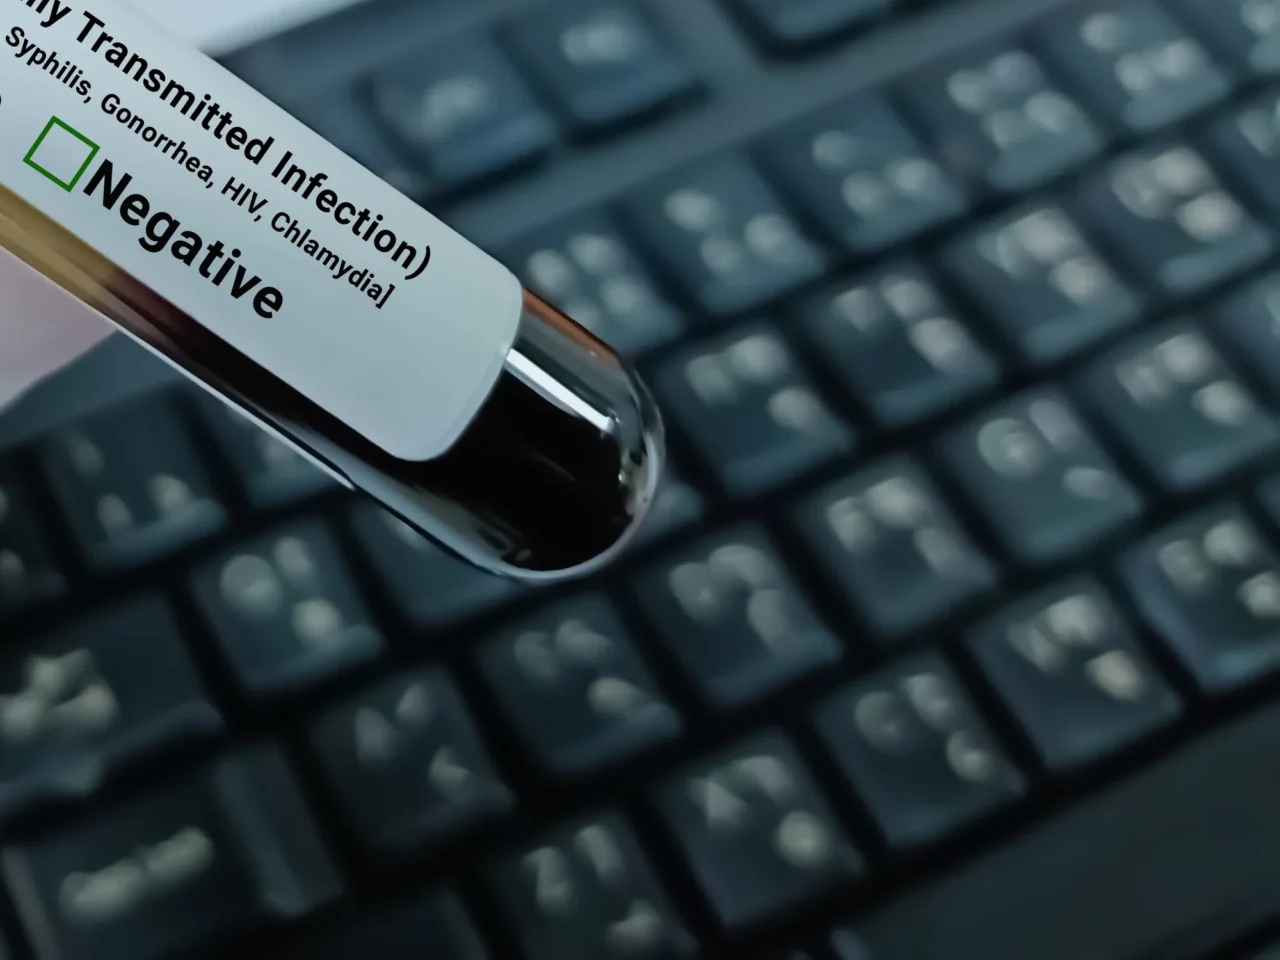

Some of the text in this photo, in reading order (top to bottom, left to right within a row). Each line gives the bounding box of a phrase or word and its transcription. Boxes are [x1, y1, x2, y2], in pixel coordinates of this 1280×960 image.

[5, 26, 92, 104] Syphilis,
[100, 93, 214, 189] Gonorrhea,
[220, 176, 269, 223] HIV,
[270, 211, 396, 310] Chlamydia]
[76, 10, 275, 165] Transmitted
[271, 150, 431, 281] Infection)
[82, 158, 284, 319] Negative
